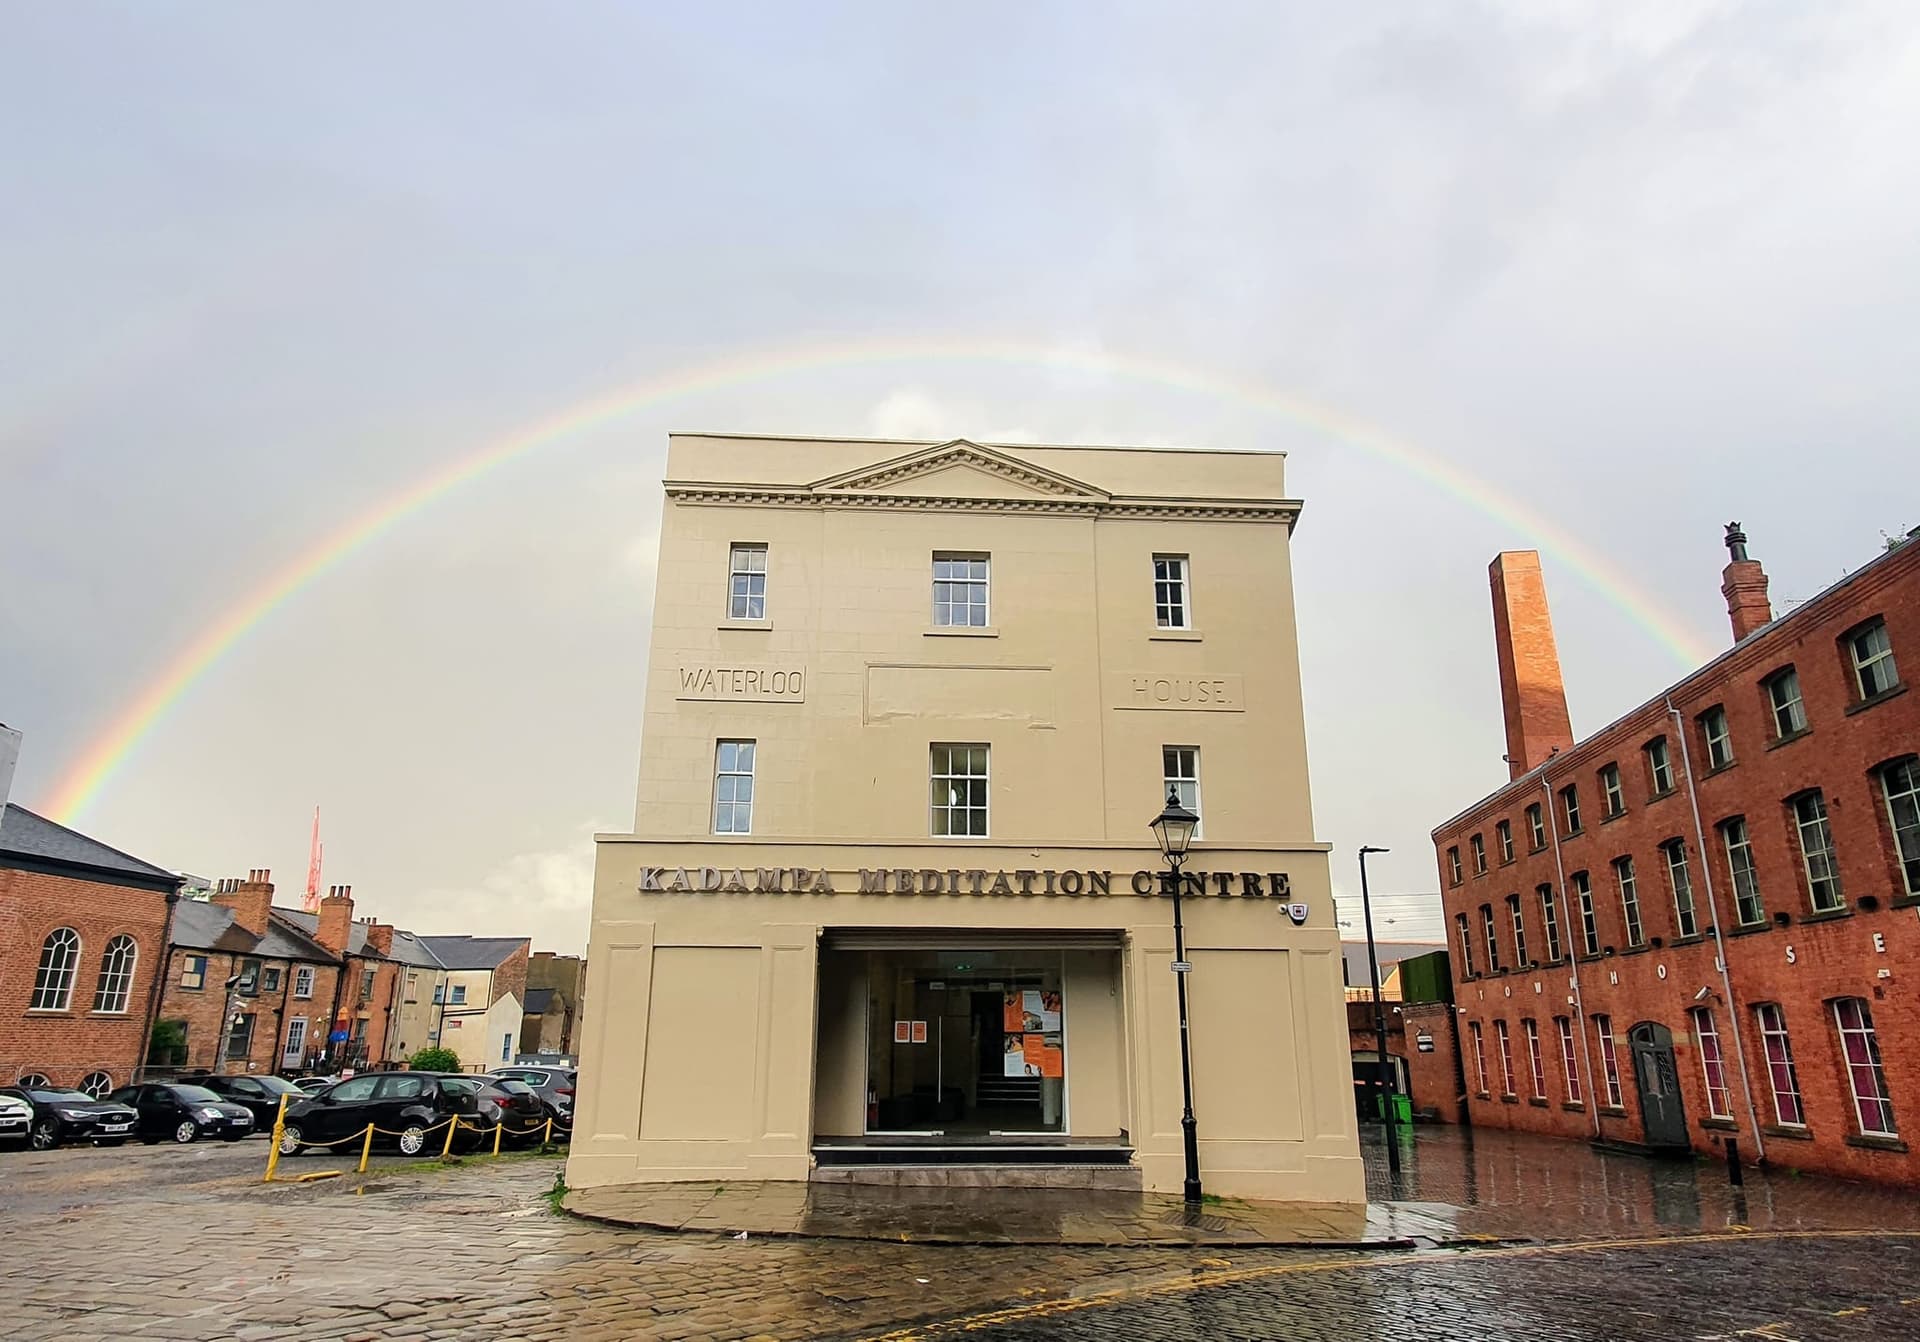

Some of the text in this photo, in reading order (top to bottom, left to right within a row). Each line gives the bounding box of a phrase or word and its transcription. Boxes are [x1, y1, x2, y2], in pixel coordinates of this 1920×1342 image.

[680, 668, 802, 694] WATERLOO
[638, 866, 1290, 898] KADAMPA MEDITATION CENTRE
